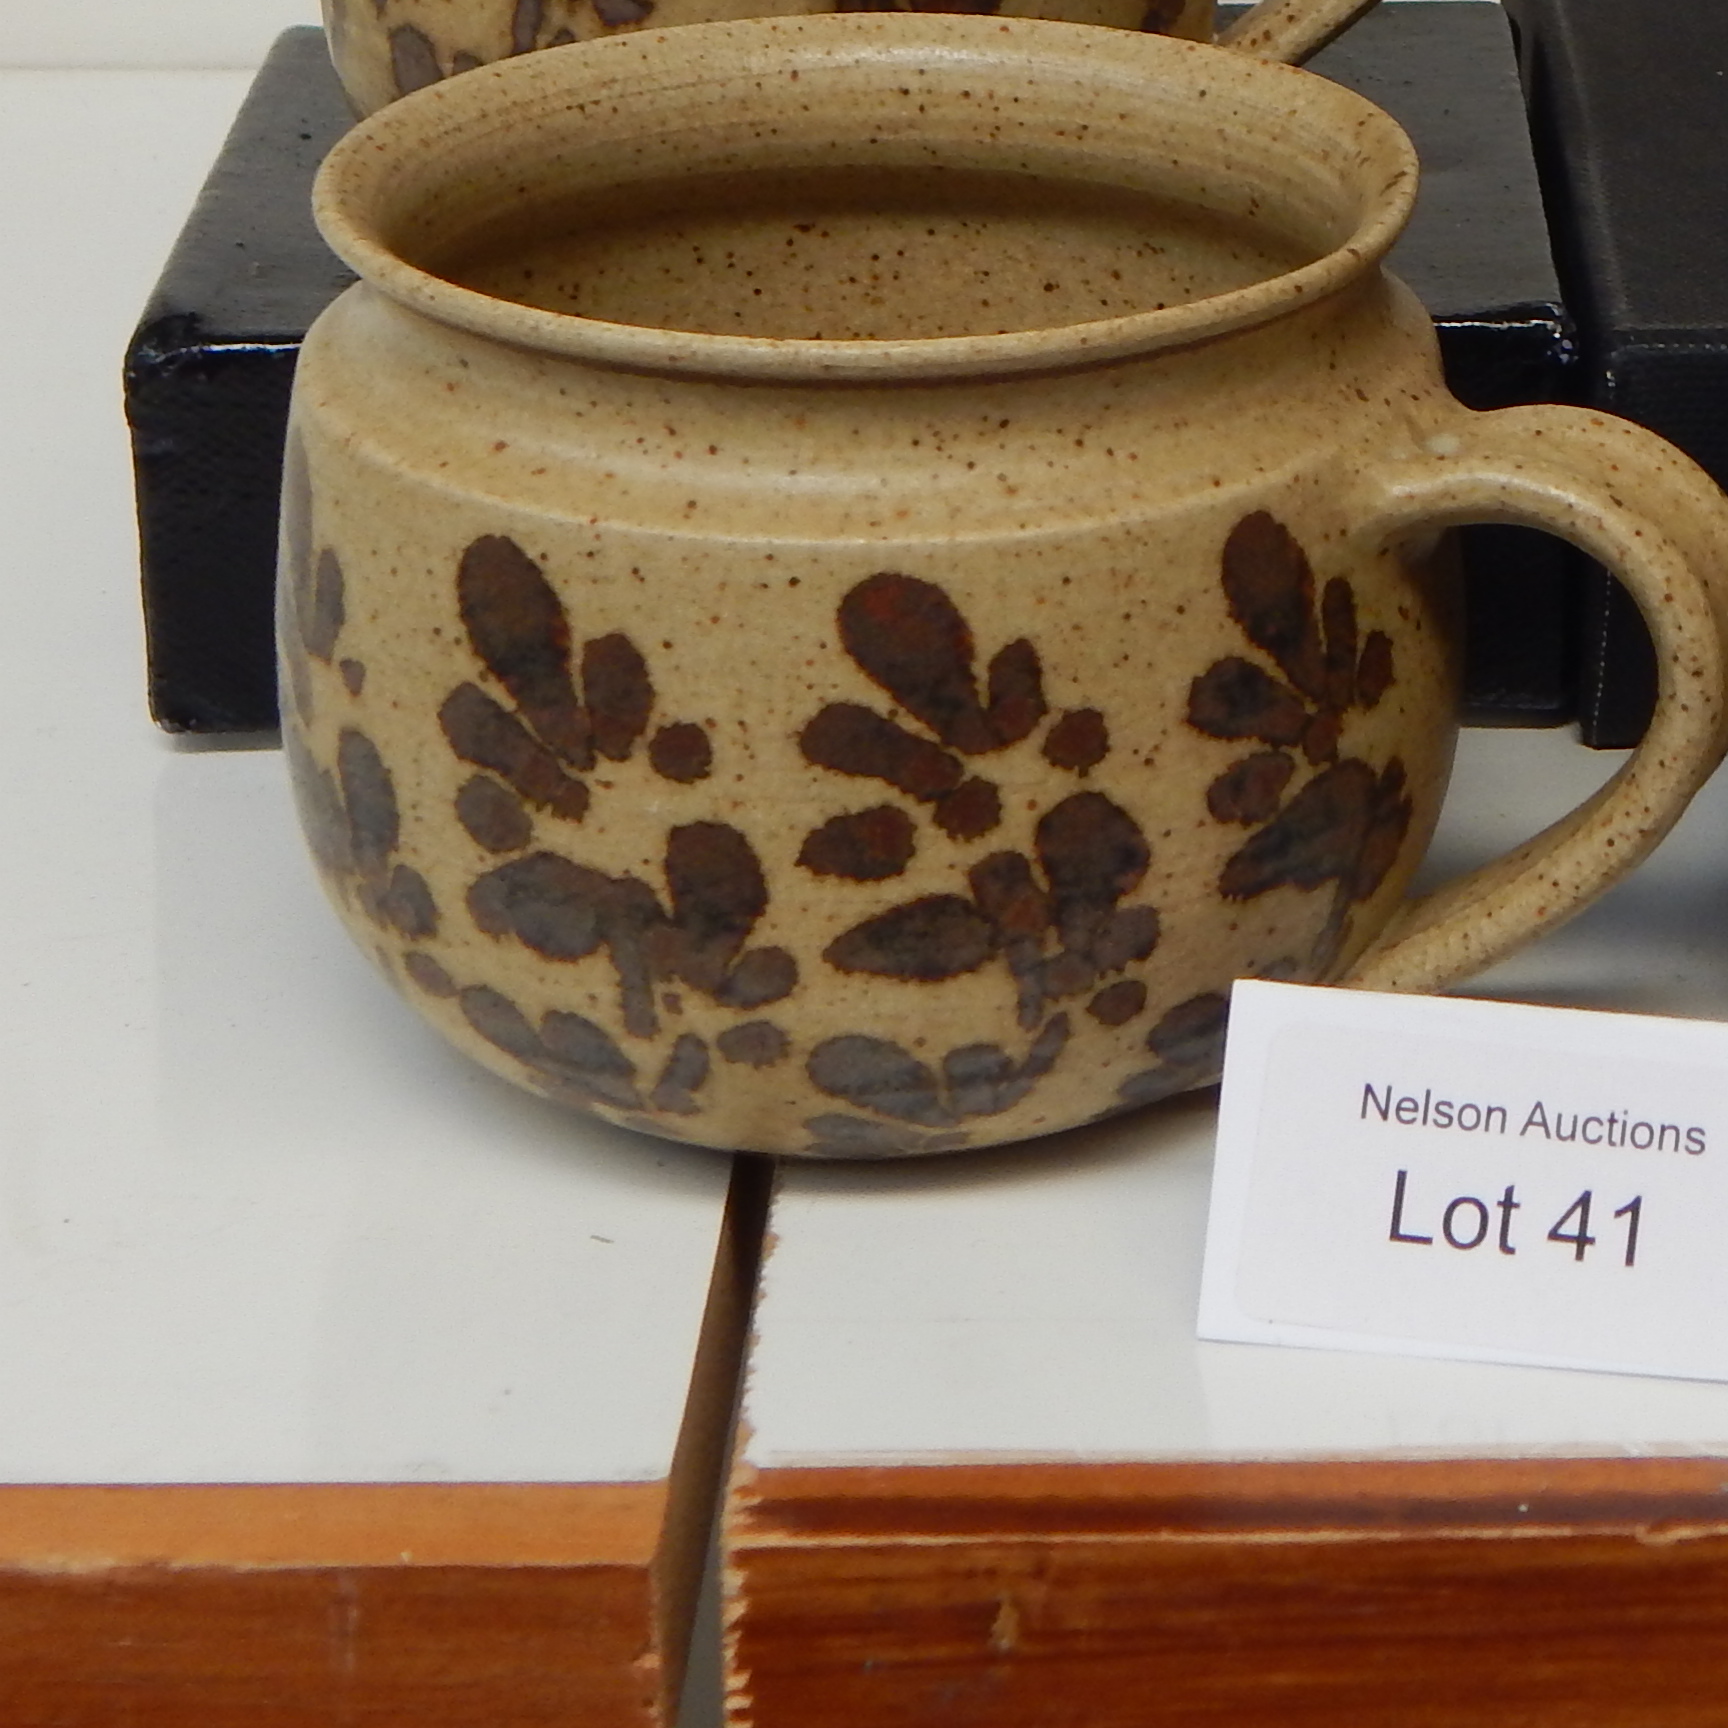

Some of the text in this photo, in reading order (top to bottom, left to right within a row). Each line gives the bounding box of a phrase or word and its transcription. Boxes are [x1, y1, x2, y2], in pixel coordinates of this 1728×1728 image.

[1360, 1083, 1707, 1155] Nelson Auctions
[1388, 1169, 1643, 1267] Lot 41
